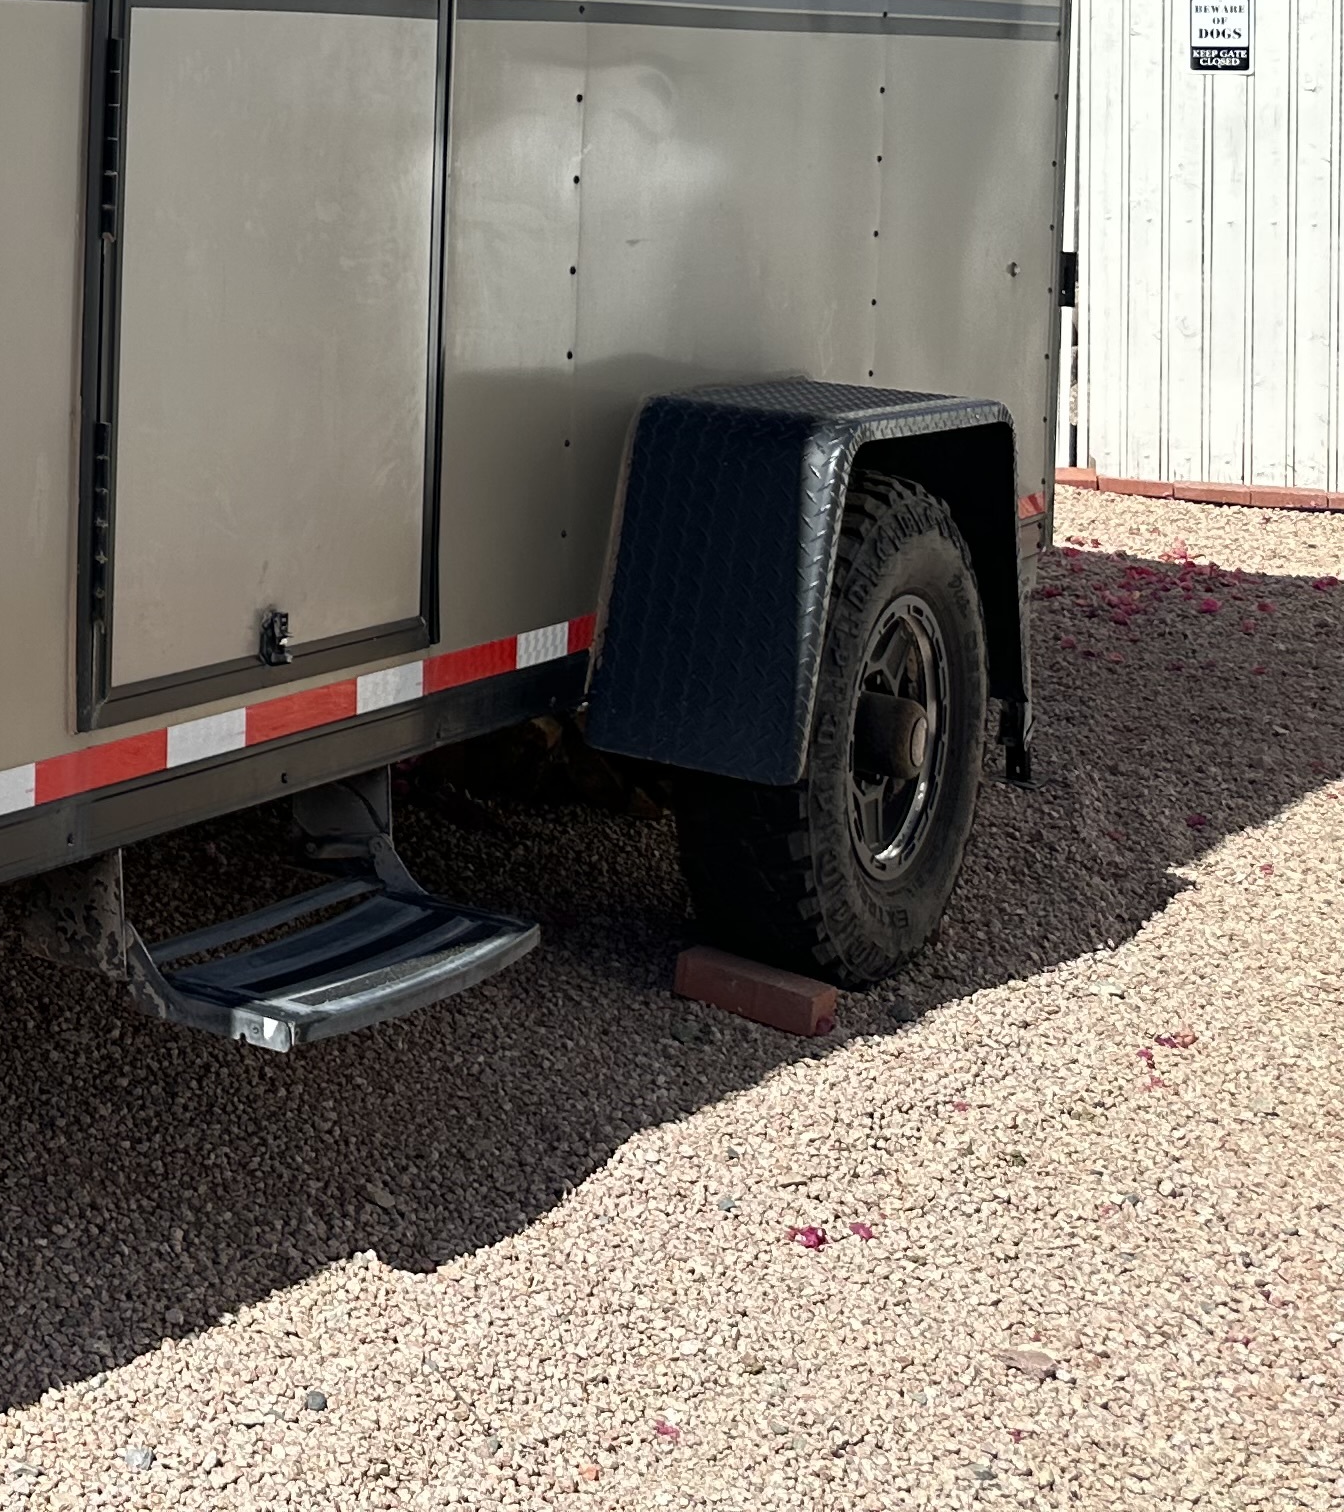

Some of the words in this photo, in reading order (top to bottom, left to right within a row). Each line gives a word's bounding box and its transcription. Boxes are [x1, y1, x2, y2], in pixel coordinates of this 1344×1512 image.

[1194, 5, 1246, 13] BEWARE
[1212, 17, 1228, 25] OF
[1198, 28, 1242, 39] DOGS
[1193, 49, 1219, 58] KEEP
[1219, 49, 1248, 58] GATE
[1199, 58, 1241, 66] CLOSED
